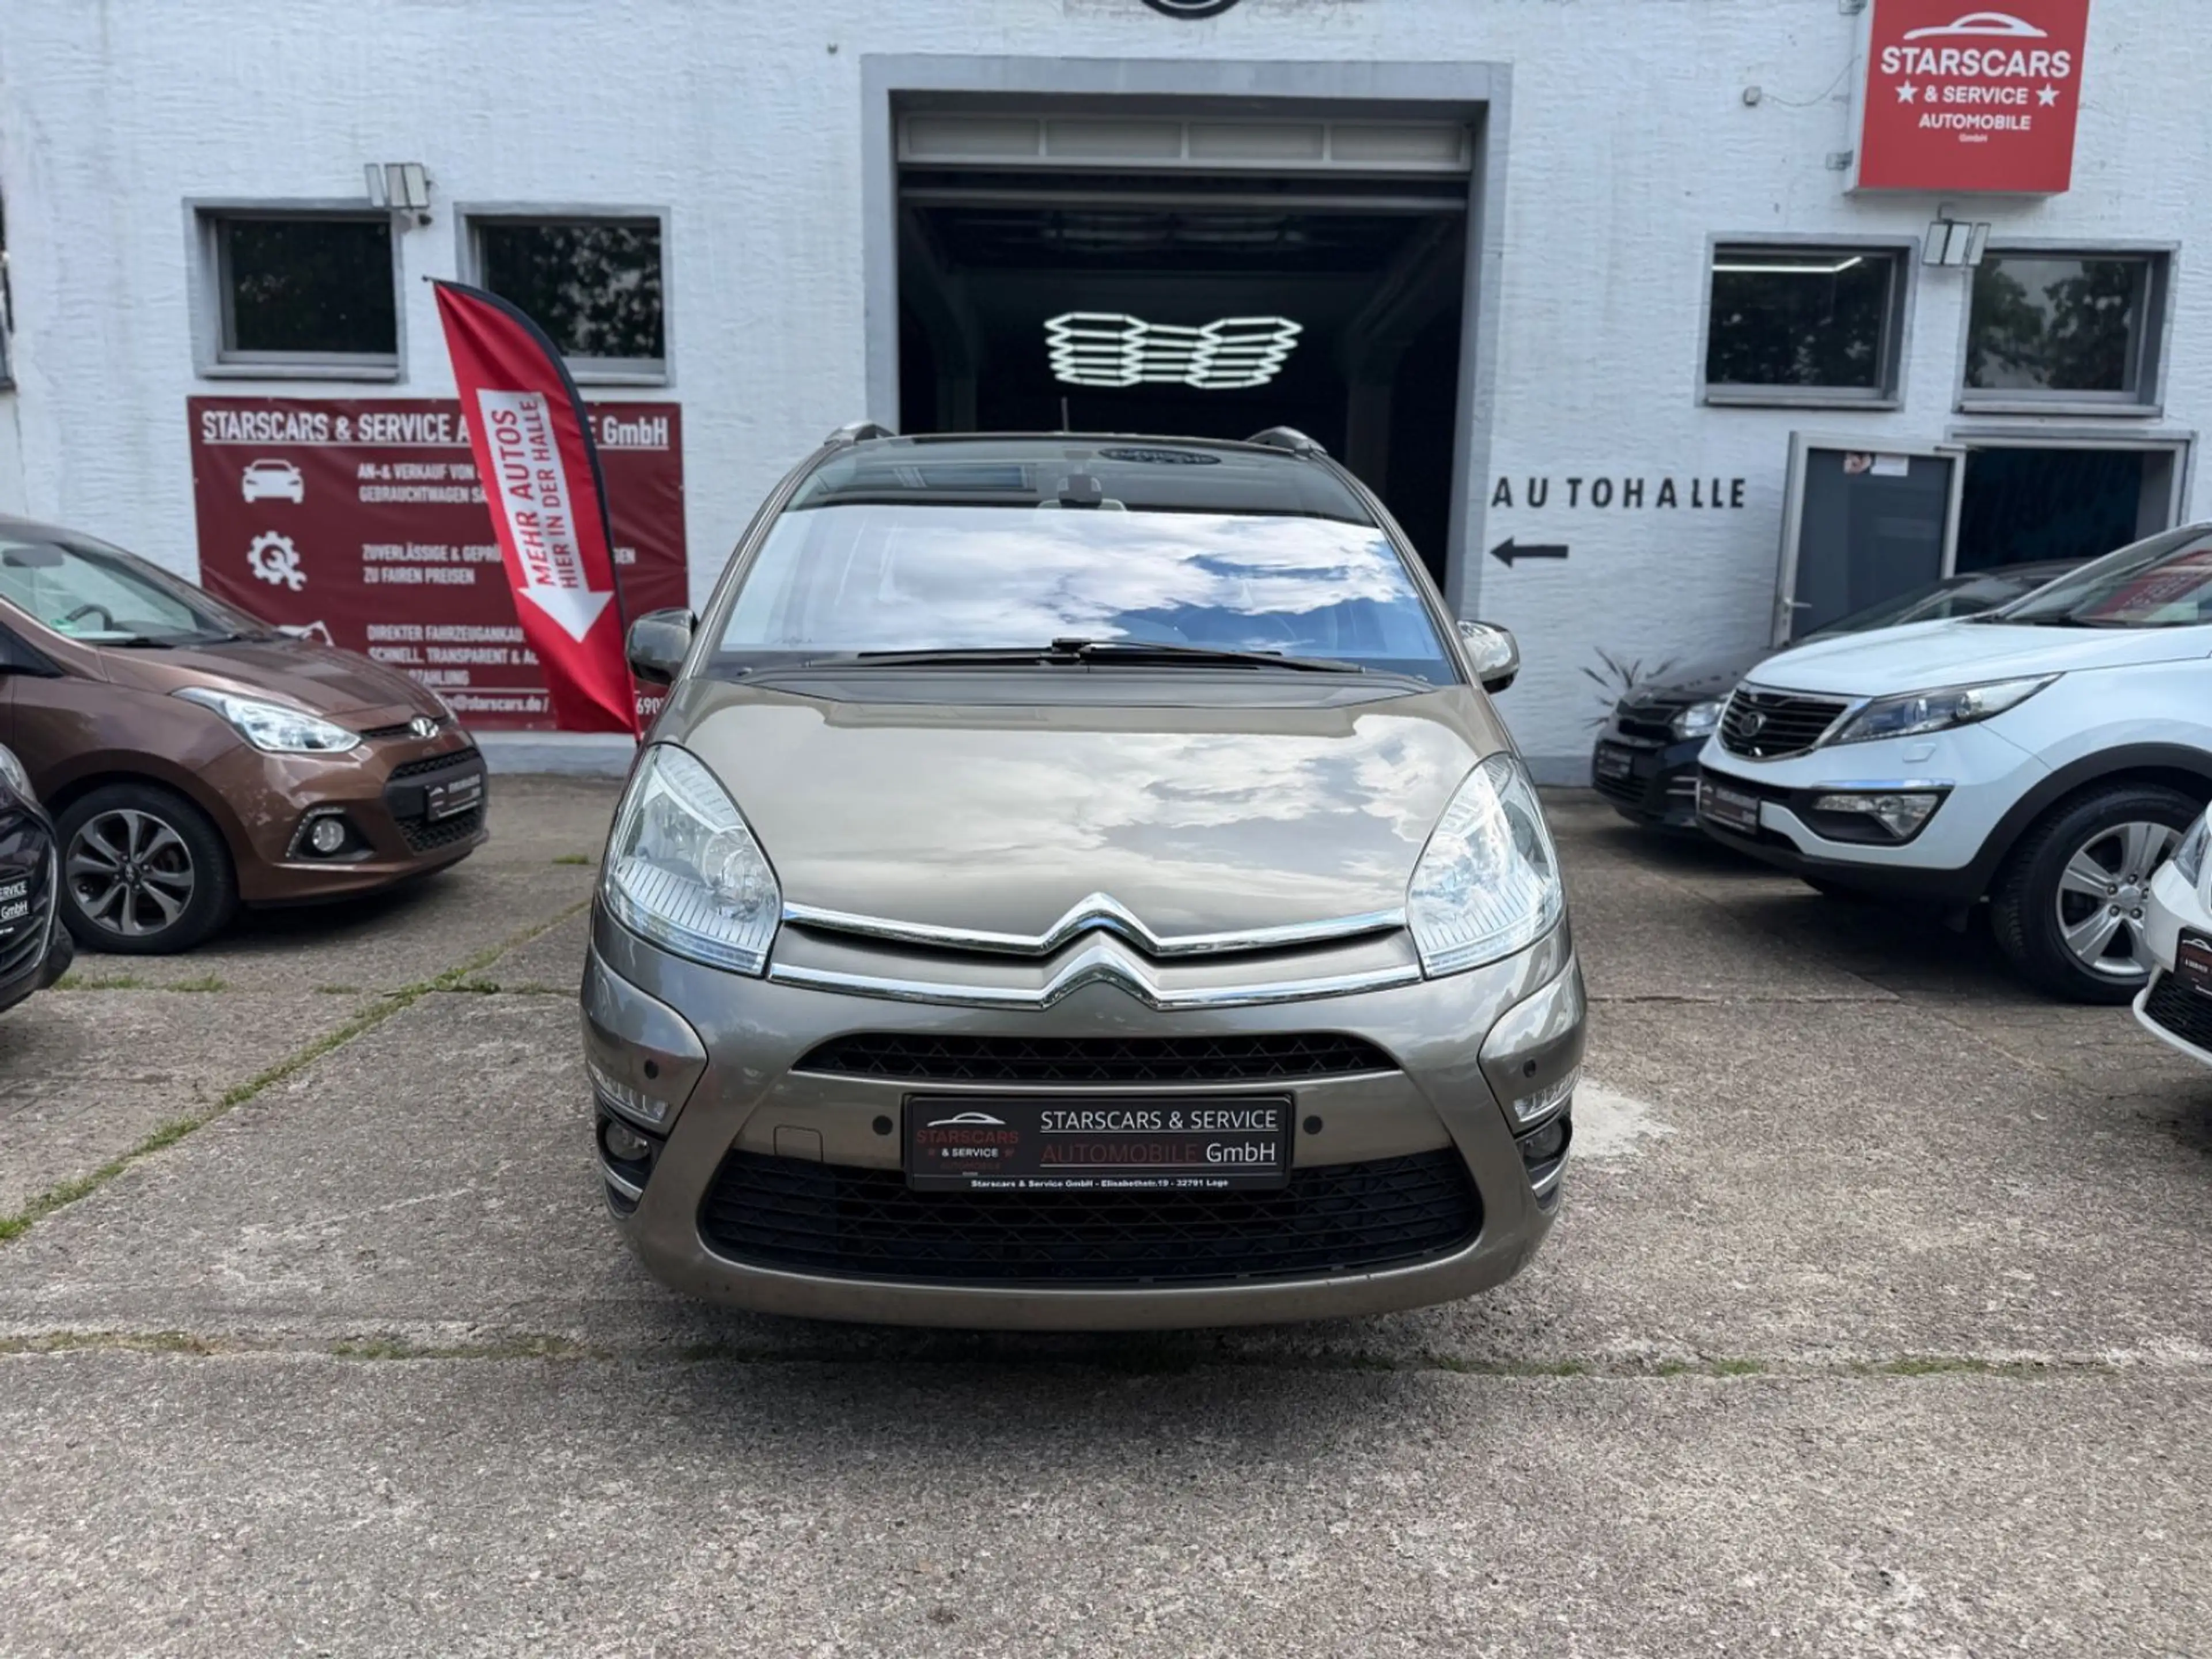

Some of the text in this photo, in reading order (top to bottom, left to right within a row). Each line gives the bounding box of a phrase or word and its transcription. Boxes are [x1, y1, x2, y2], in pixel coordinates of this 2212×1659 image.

[1880, 46, 2071, 78] STARSCARS
[1923, 85, 2029, 105] & SERVICE
[1919, 113, 2032, 130] AUTOMOBILE
[202, 411, 328, 441] STARSCARS
[335, 415, 351, 441] &
[358, 413, 451, 442] SERVICE
[603, 415, 668, 445] GmbH
[393, 463, 446, 480] VERKAUF
[450, 464, 476, 480] VON
[359, 485, 469, 503] GEBRAUCHTWAGEN
[491, 410, 556, 586] MEHR AUTOS
[521, 400, 578, 589] HIER IN DER HALLE
[1491, 477, 1745, 508] AUTOHALLE
[362, 541, 448, 561] ZUVERLÄSSIGE
[462, 544, 503, 563] GEPRÜ
[363, 566, 475, 584] ZU FAIREN PREISEN
[367, 624, 525, 642] DIREKTER FAHRZEUGANKAU
[426, 647, 508, 664] TRANSPARENT
[0, 881, 27, 899] ERVICE
[1, 900, 28, 919] GmbH
[1040, 1109, 1278, 1130] STARSCARS & SERVICE
[916, 1130, 1019, 1144] STARSCARS
[941, 1148, 998, 1157] & SERVICE
[1041, 1142, 1275, 1162] AUTOMOBILE GmbH
